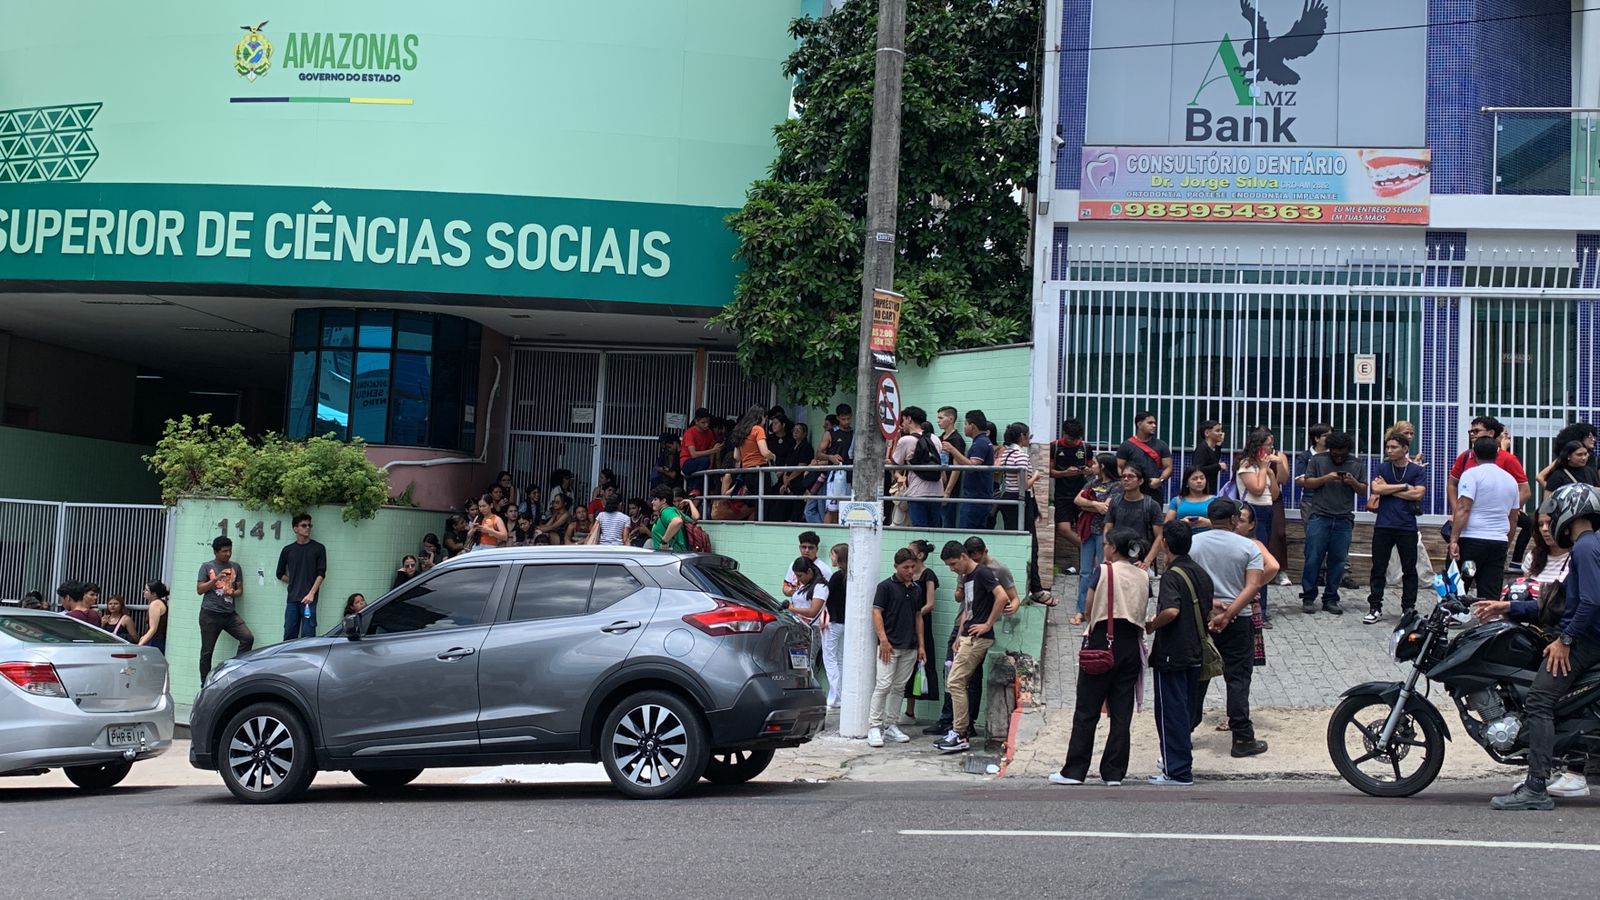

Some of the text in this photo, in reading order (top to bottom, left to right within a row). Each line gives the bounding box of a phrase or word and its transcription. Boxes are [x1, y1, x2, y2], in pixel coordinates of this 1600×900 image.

[282, 32, 419, 71] AMAZONAS
[298, 73, 401, 82] GOVERNO DO ESTADO
[1185, 107, 1297, 142] Bank
[1126, 152, 1347, 175] CONSULTÓRIO DENTÁRIO
[1151, 175, 1279, 191] Dr. Jorge Silva
[1124, 203, 1323, 220] 985954363
[196, 211, 254, 258] DE
[265, 200, 472, 267] CIÊNCIAS
[485, 220, 671, 277] SOCIAIS
[1361, 363, 1368, 373] E
[218, 518, 282, 540] 1141
